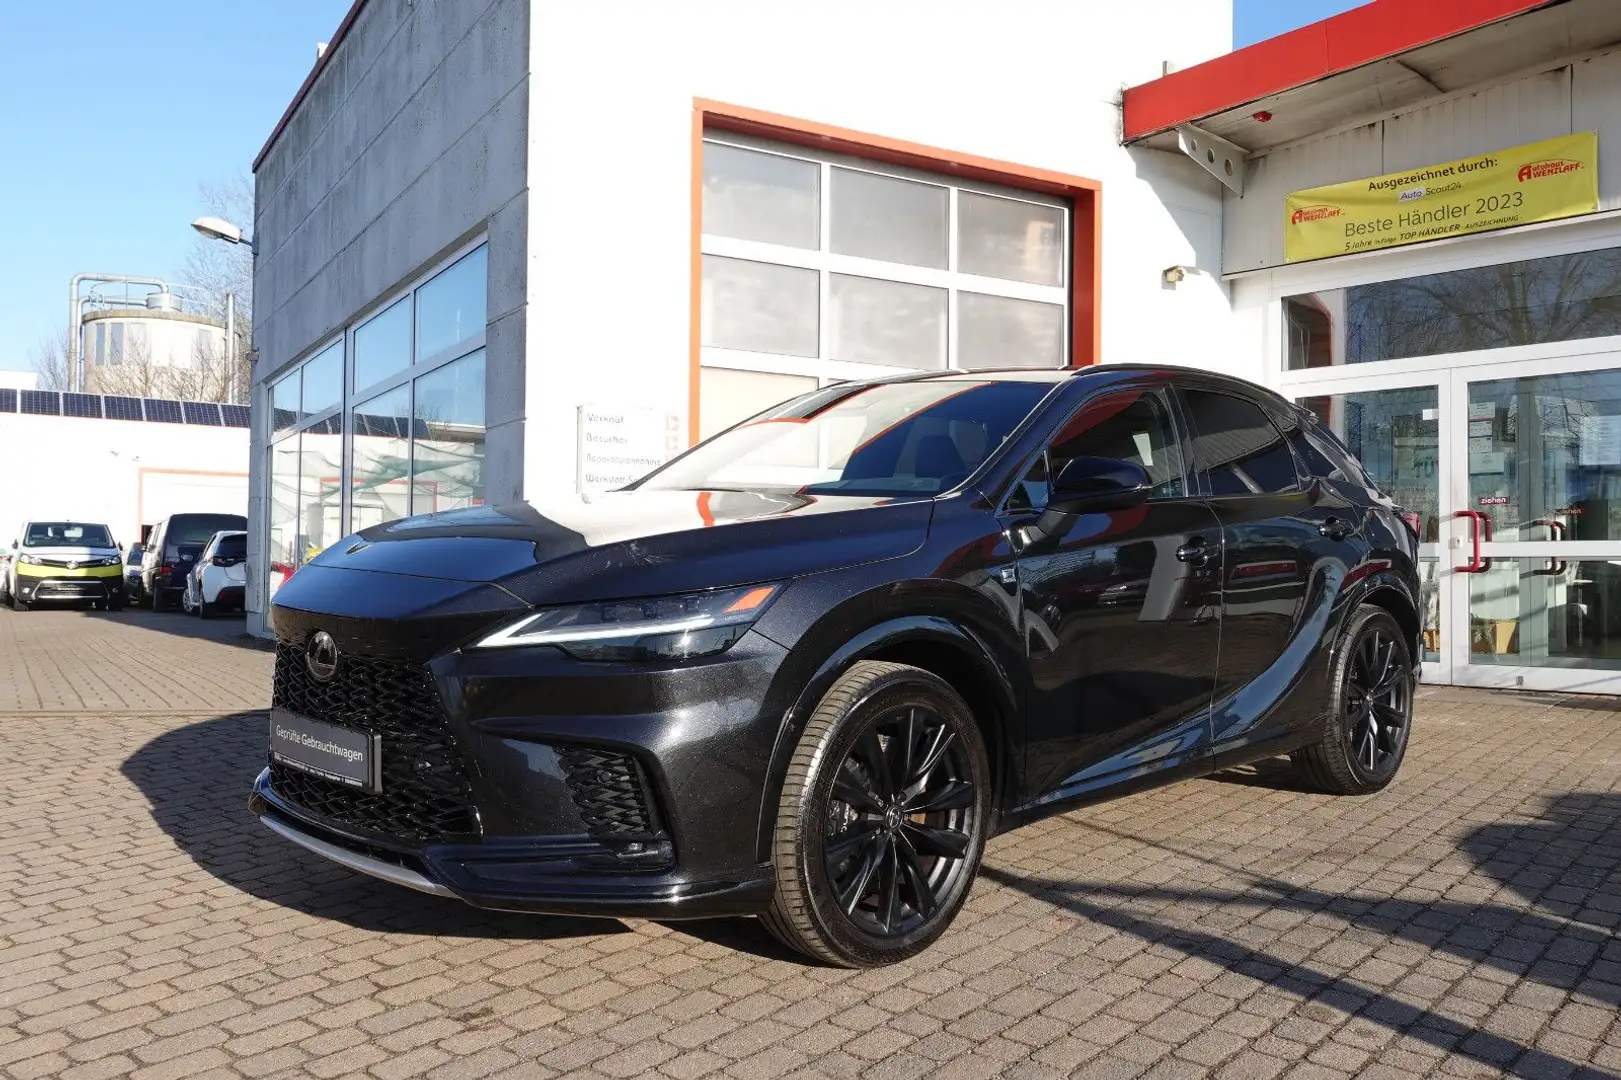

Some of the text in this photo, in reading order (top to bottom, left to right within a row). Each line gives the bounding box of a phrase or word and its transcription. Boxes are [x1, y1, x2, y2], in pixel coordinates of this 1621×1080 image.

[1368, 157, 1498, 191] Ausgezeichnet durch:
[1532, 162, 1580, 178] WENZLAFF
[1400, 181, 1462, 200] Auto Scout24
[1303, 209, 1341, 221] WENZLAFF
[1345, 192, 1523, 237] Beste Händler 2023
[1344, 241, 1351, 251] 5
[1400, 230, 1417, 241] TOP
[1418, 223, 1460, 237] HÄNDLER
[1465, 215, 1519, 229] AUSZEICHNUNG
[1481, 496, 1507, 504] ziehen
[276, 724, 363, 762] Geprüfte Gebrauchtwagen
